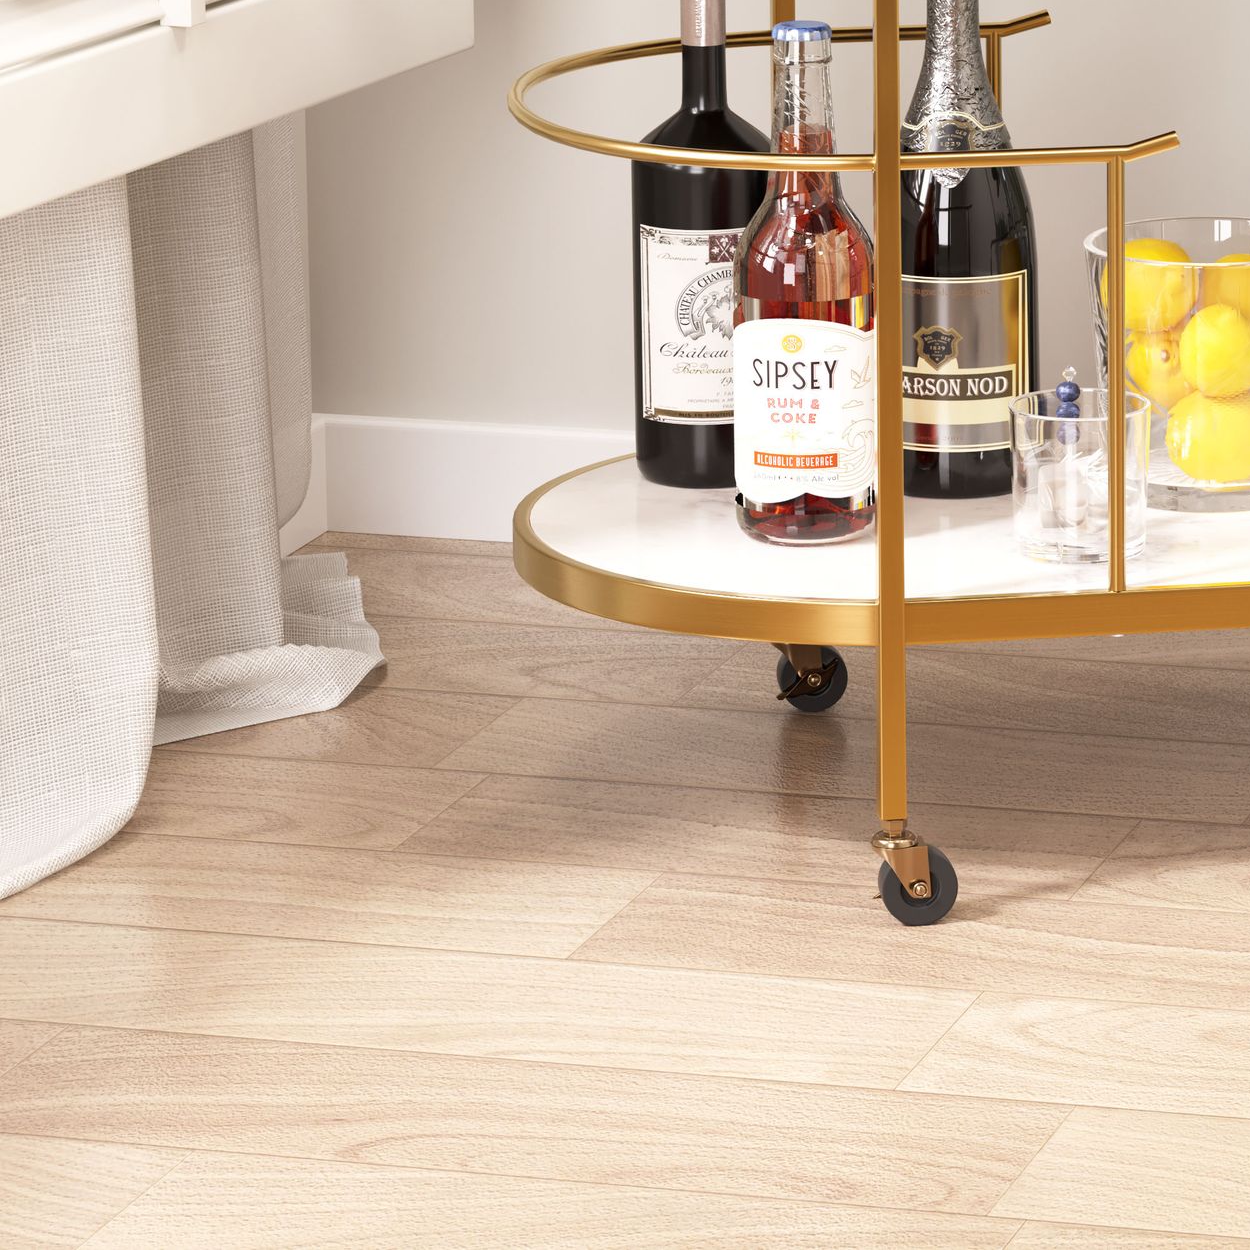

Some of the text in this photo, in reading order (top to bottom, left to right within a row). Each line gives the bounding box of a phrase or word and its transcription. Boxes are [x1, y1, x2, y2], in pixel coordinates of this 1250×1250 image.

[679, 269, 733, 326] CHATEAU CHAMB
[753, 358, 837, 390] SIPSEY
[966, 376, 1009, 396] NOD
[767, 398, 820, 410] RUM &
[770, 412, 817, 424] COKE
[757, 453, 833, 467] ALCOHOLIC BEVERAGE
